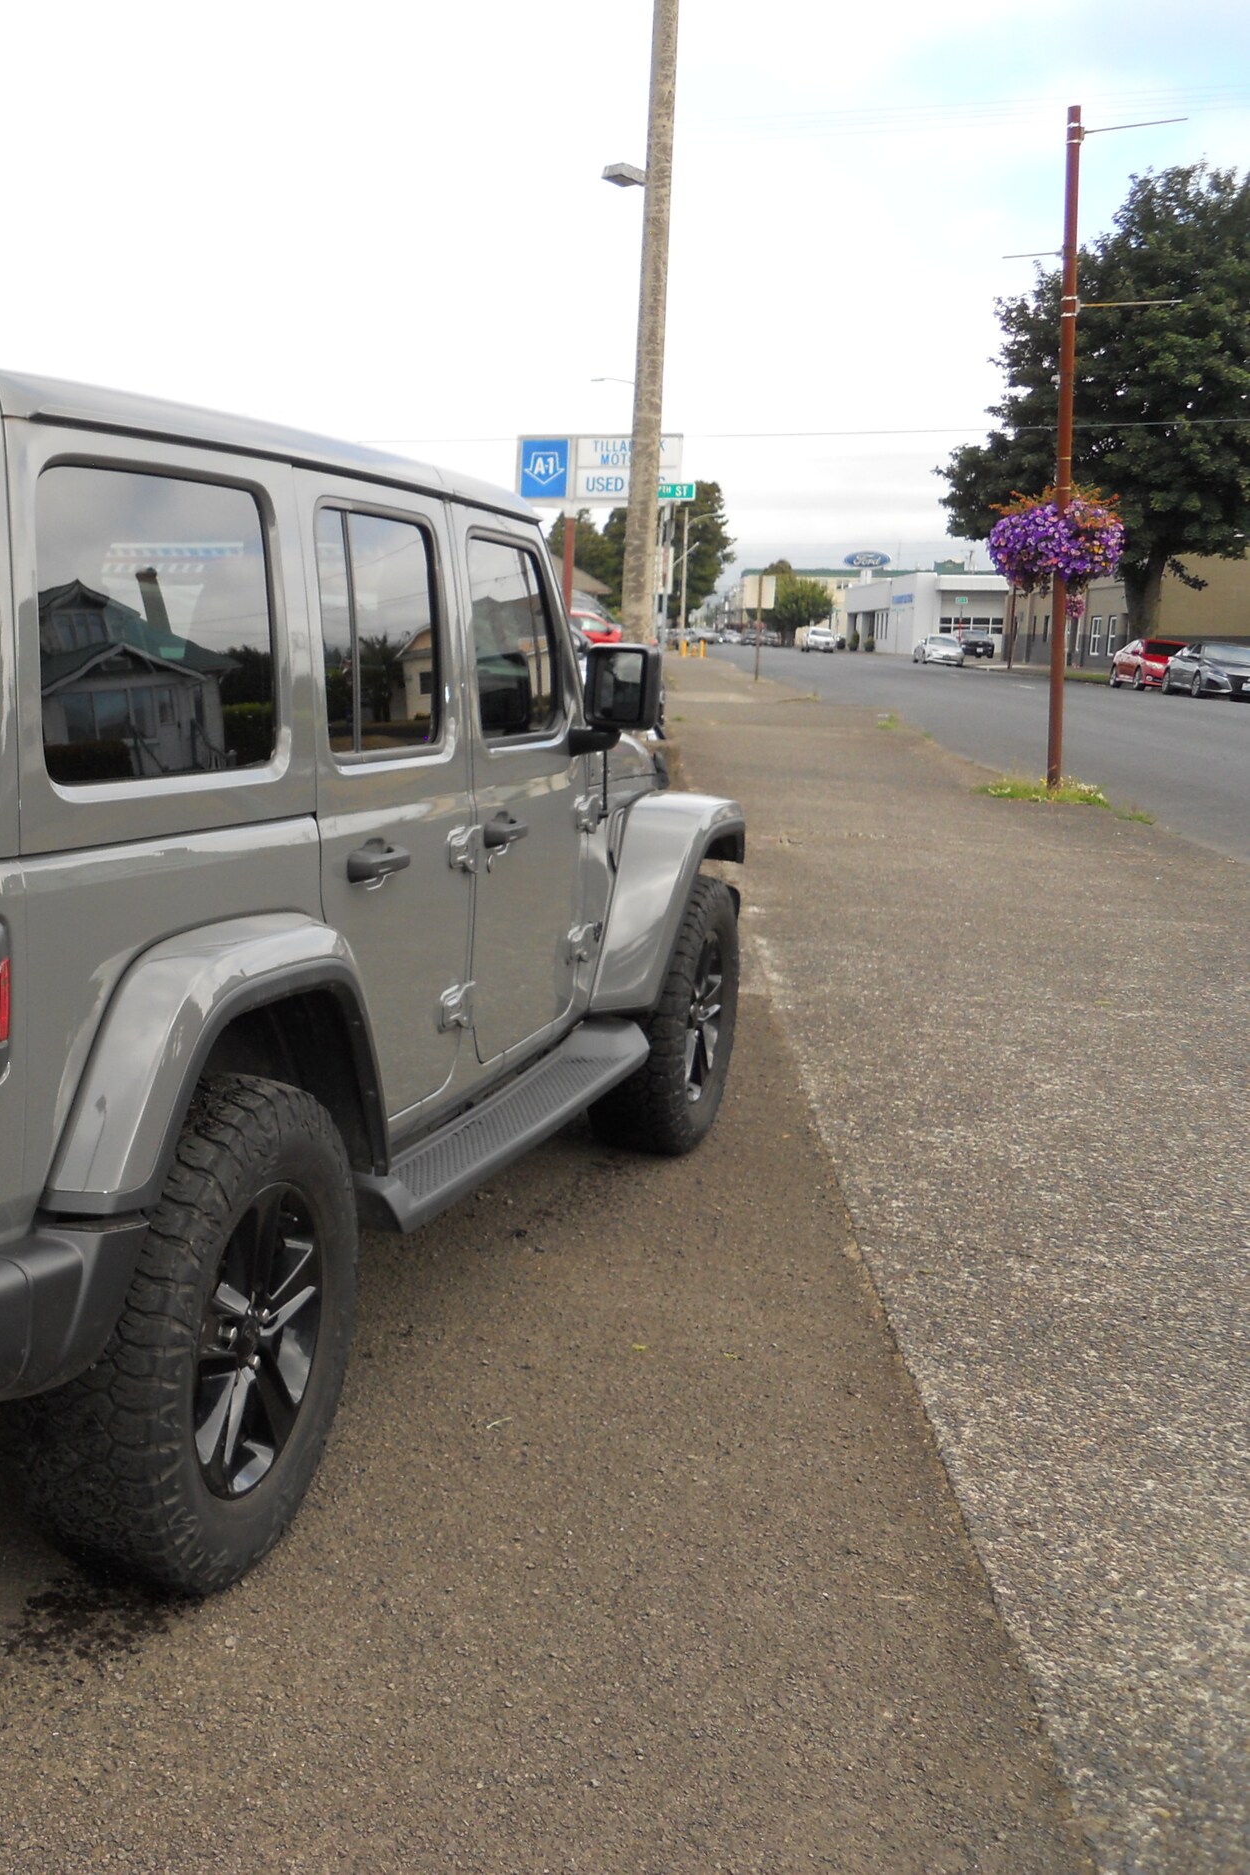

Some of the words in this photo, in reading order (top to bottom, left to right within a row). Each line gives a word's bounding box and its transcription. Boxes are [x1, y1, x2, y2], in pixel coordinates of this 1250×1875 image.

[594, 440, 665, 452] TILLAK
[586, 476, 625, 493] USED
[675, 485, 688, 497] ST
[853, 553, 882, 567] Ford
